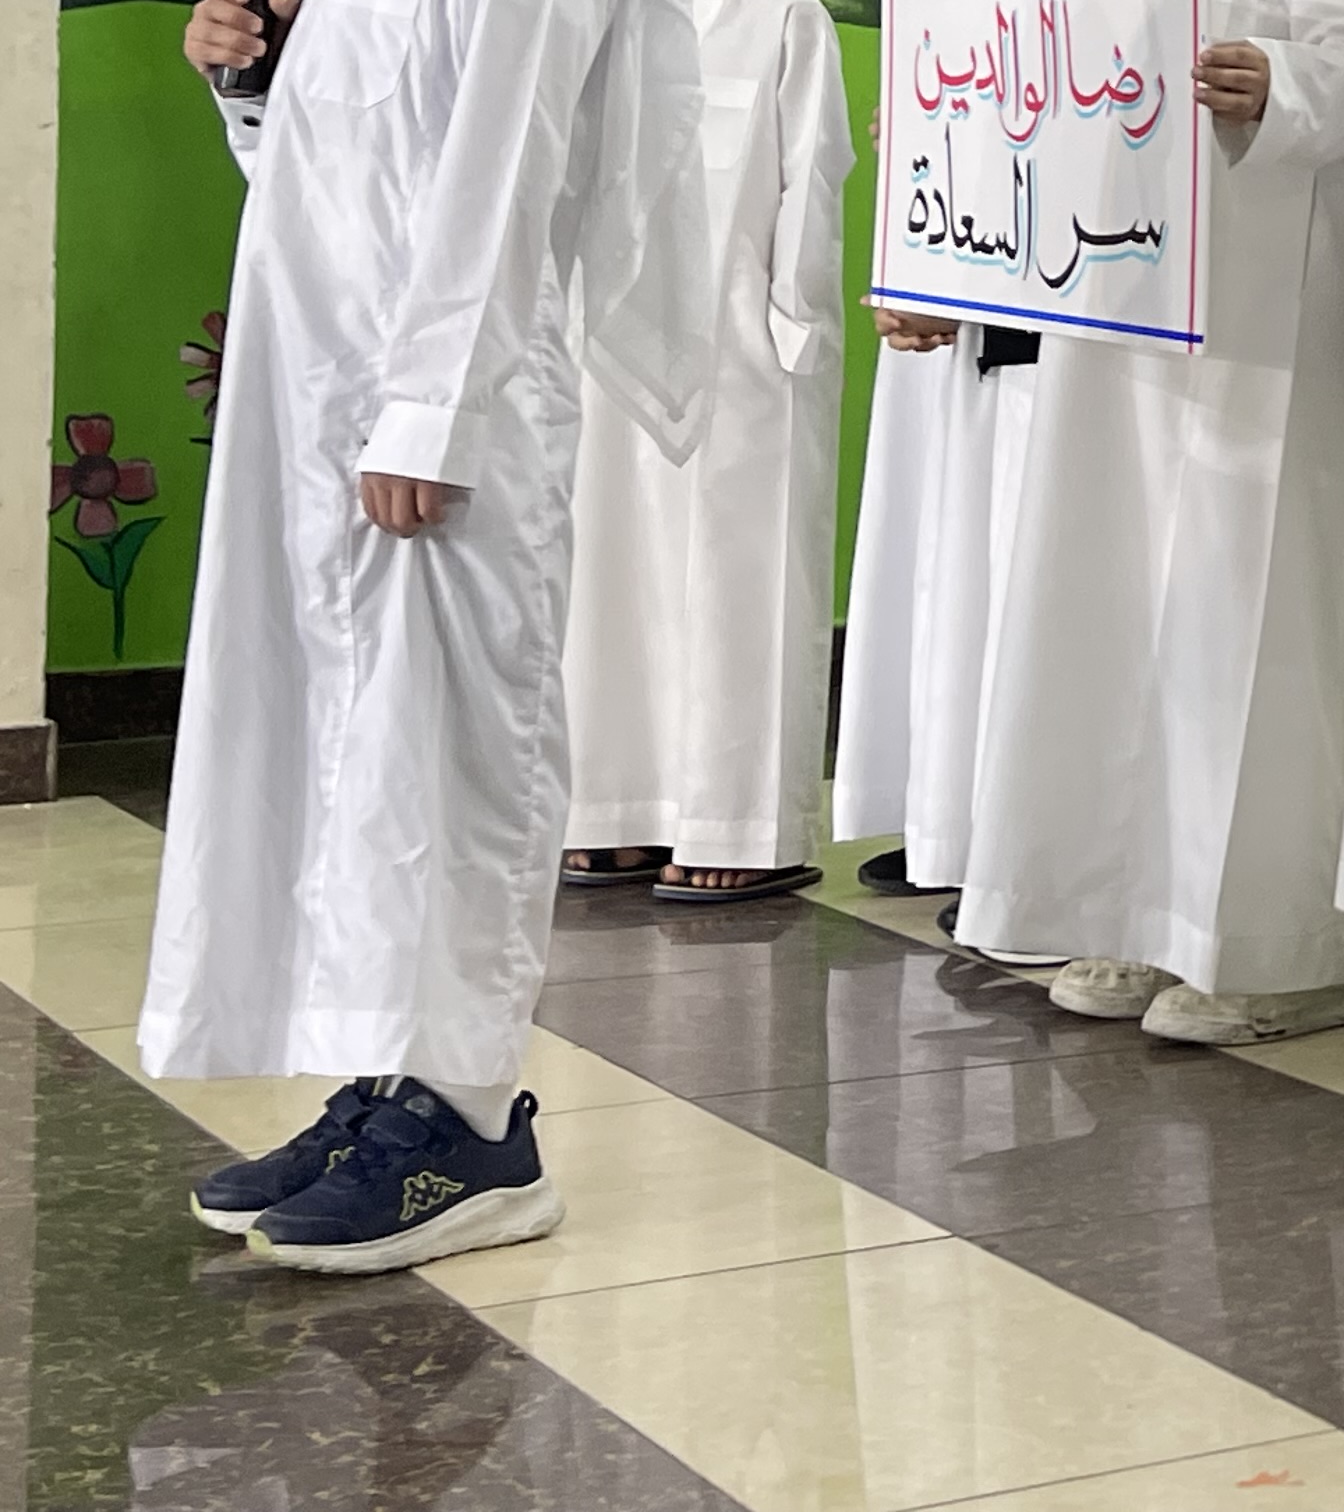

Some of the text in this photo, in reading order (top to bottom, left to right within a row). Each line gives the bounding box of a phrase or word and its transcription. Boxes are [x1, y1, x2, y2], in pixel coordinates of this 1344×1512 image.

[1062, 0, 1166, 145] رضا
[906, 122, 1167, 291] سر السعادة
